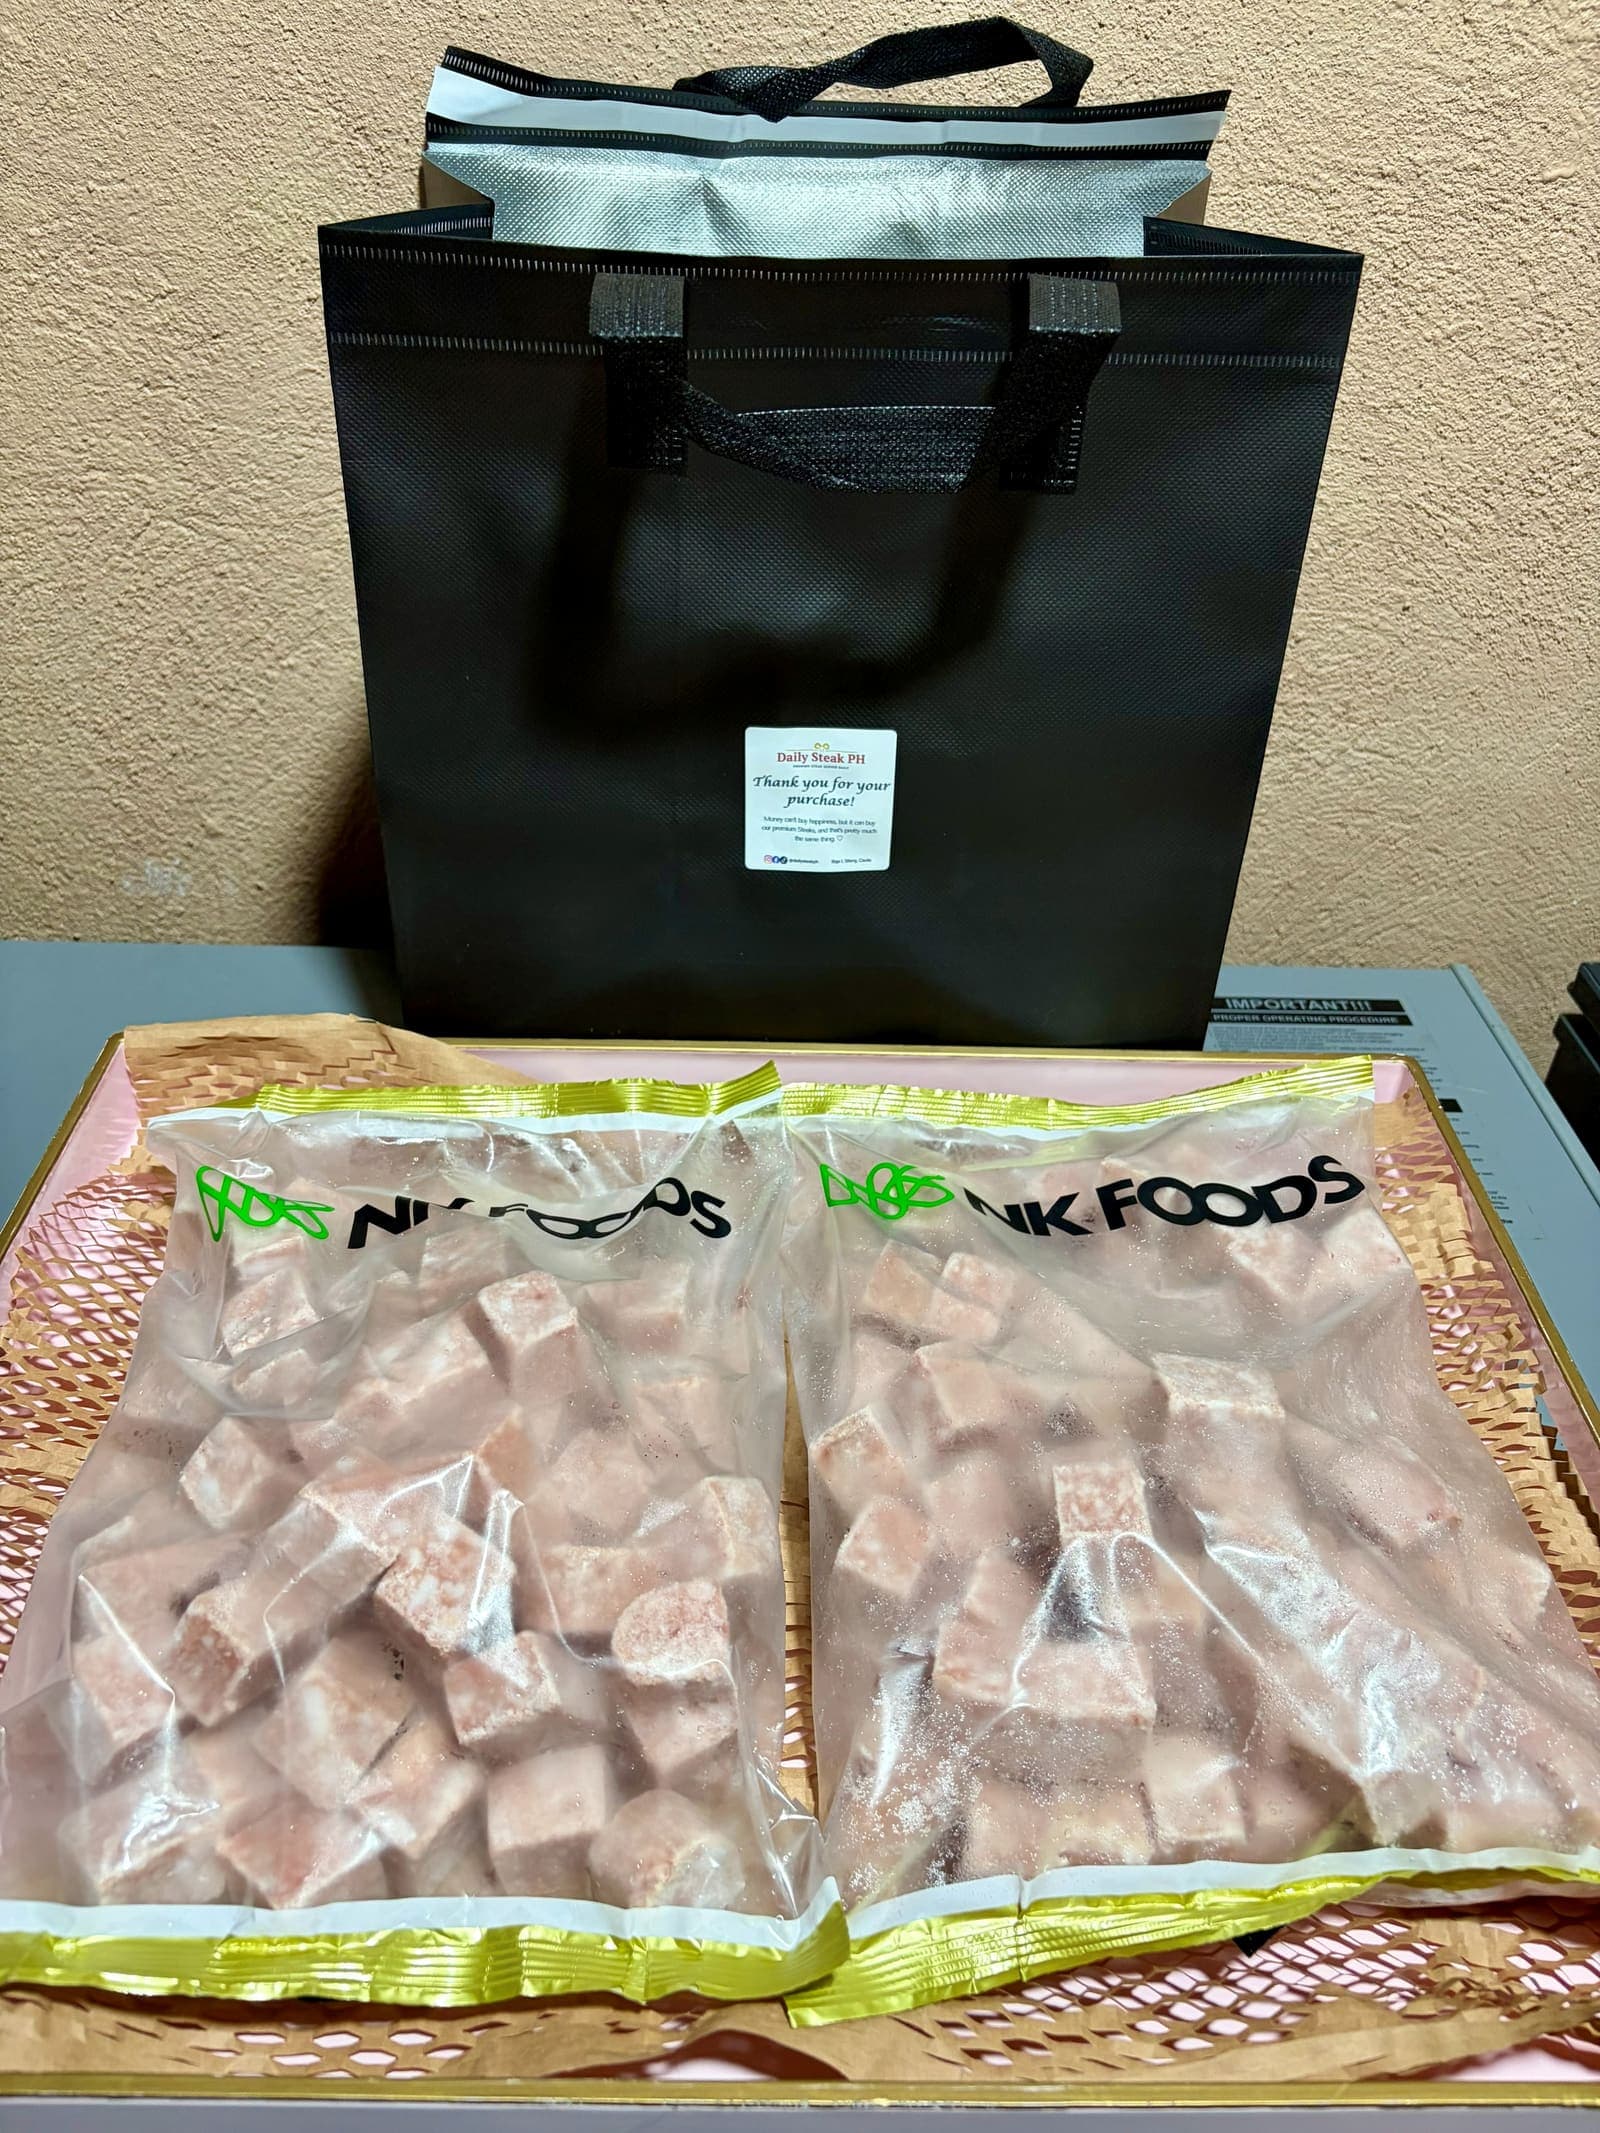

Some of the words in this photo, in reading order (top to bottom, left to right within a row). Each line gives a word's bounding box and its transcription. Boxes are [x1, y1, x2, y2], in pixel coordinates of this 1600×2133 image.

[777, 752, 809, 764] Daily
[811, 752, 845, 764] Steak
[848, 754, 865, 764] PH
[753, 775, 799, 788] Thank
[801, 779, 829, 792] you
[828, 776, 854, 793] for
[856, 781, 891, 795] your
[783, 792, 855, 808] purchase!
[1224, 998, 1372, 1012] IMPORTANT!!!
[1213, 1013, 1260, 1023] PROPER
[1262, 1014, 1328, 1024] OPERATING
[1328, 1015, 1400, 1024] PROCEDURE
[963, 1187, 1094, 1237] NK
[1095, 1154, 1366, 1231] FOODS
